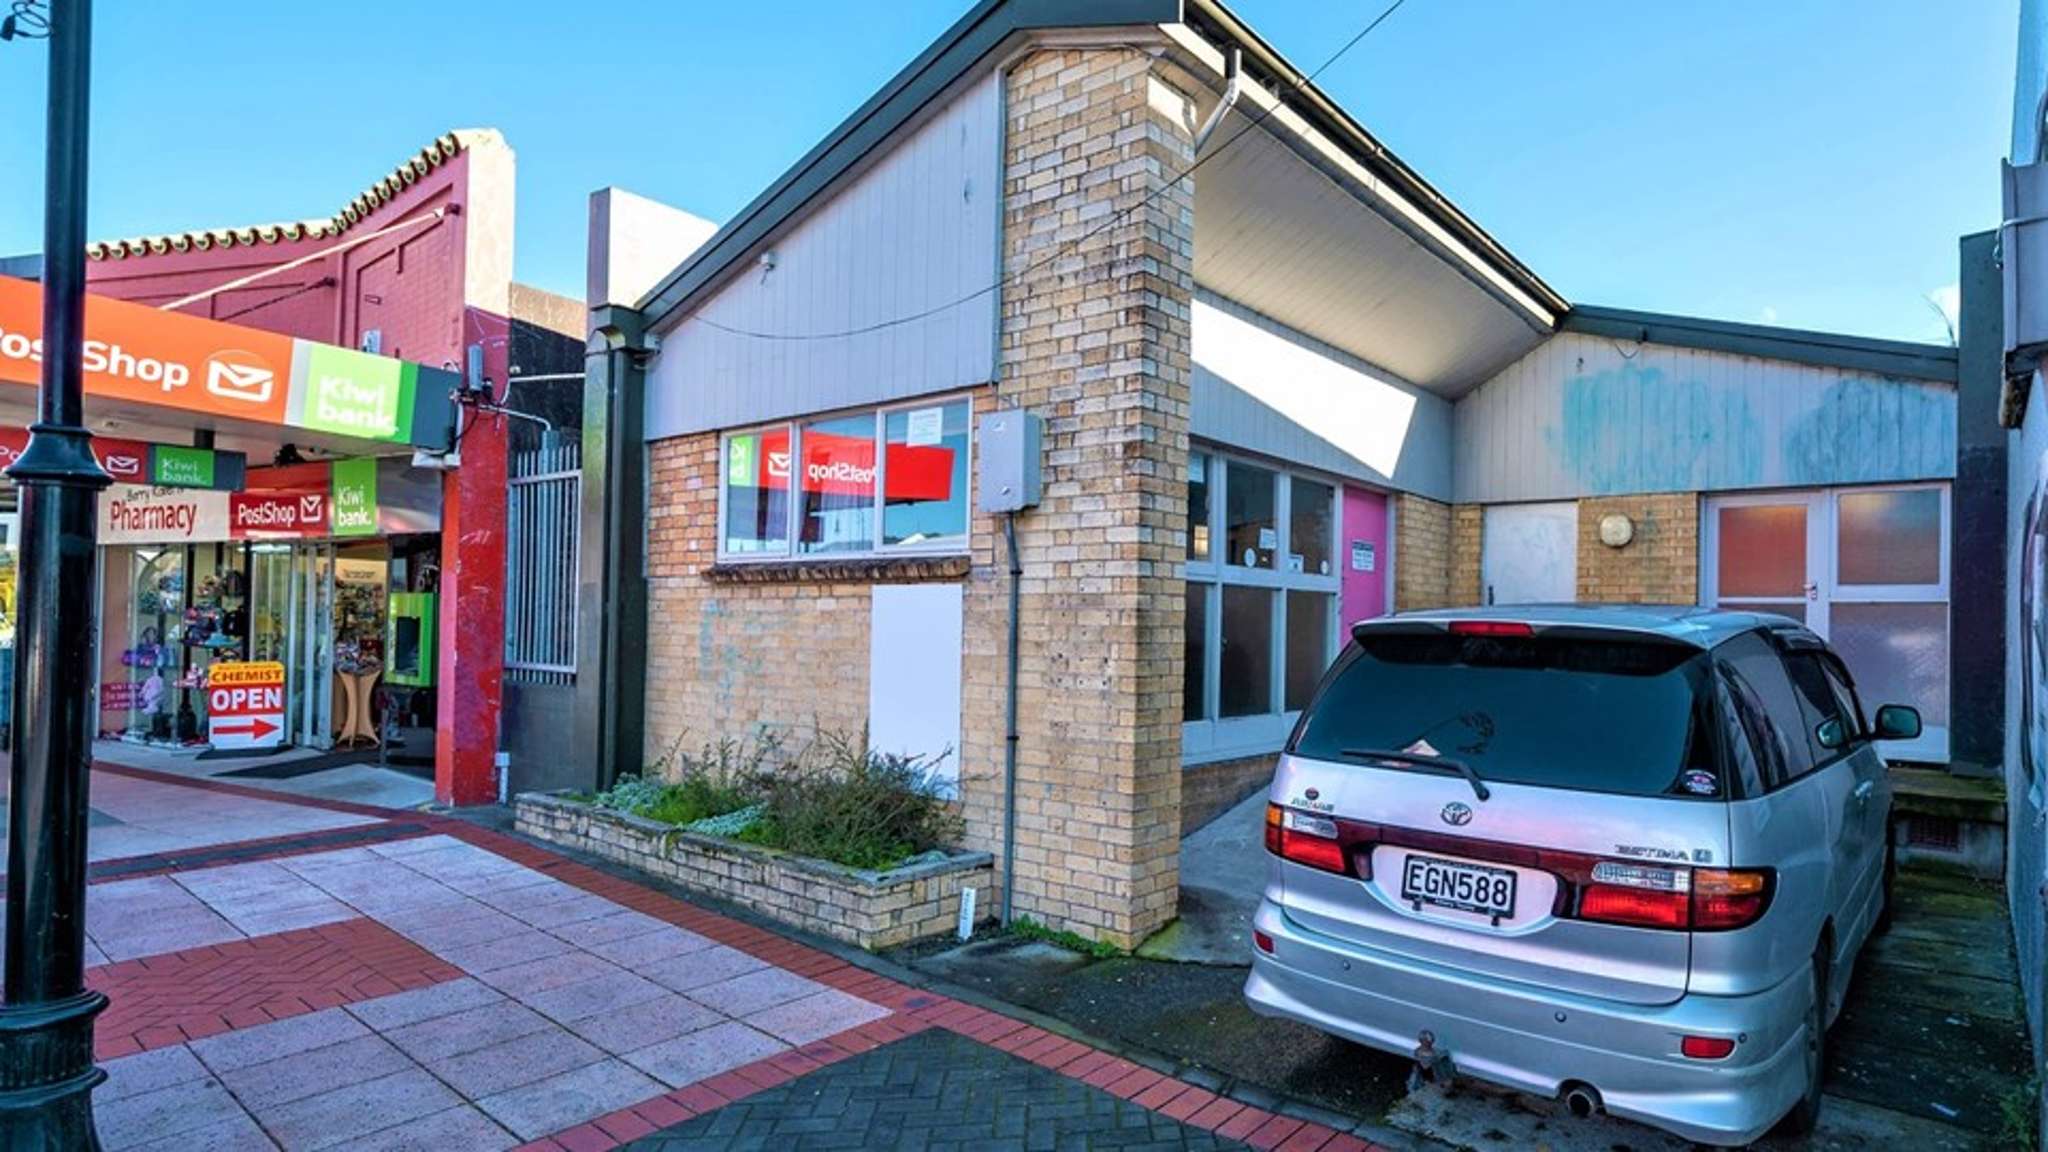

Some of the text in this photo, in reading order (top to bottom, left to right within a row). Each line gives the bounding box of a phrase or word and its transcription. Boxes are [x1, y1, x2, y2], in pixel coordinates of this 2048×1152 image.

[0, 327, 190, 392] osShop
[319, 376, 387, 406] Kiwi
[162, 457, 199, 472] Kiwi
[338, 485, 365, 506] Kiwi
[110, 500, 198, 537] Pharmacy
[237, 500, 297, 528] PostShop
[212, 669, 282, 684] CHEMIST
[211, 686, 283, 712] OPEN
[1408, 863, 1508, 908] EGN588
